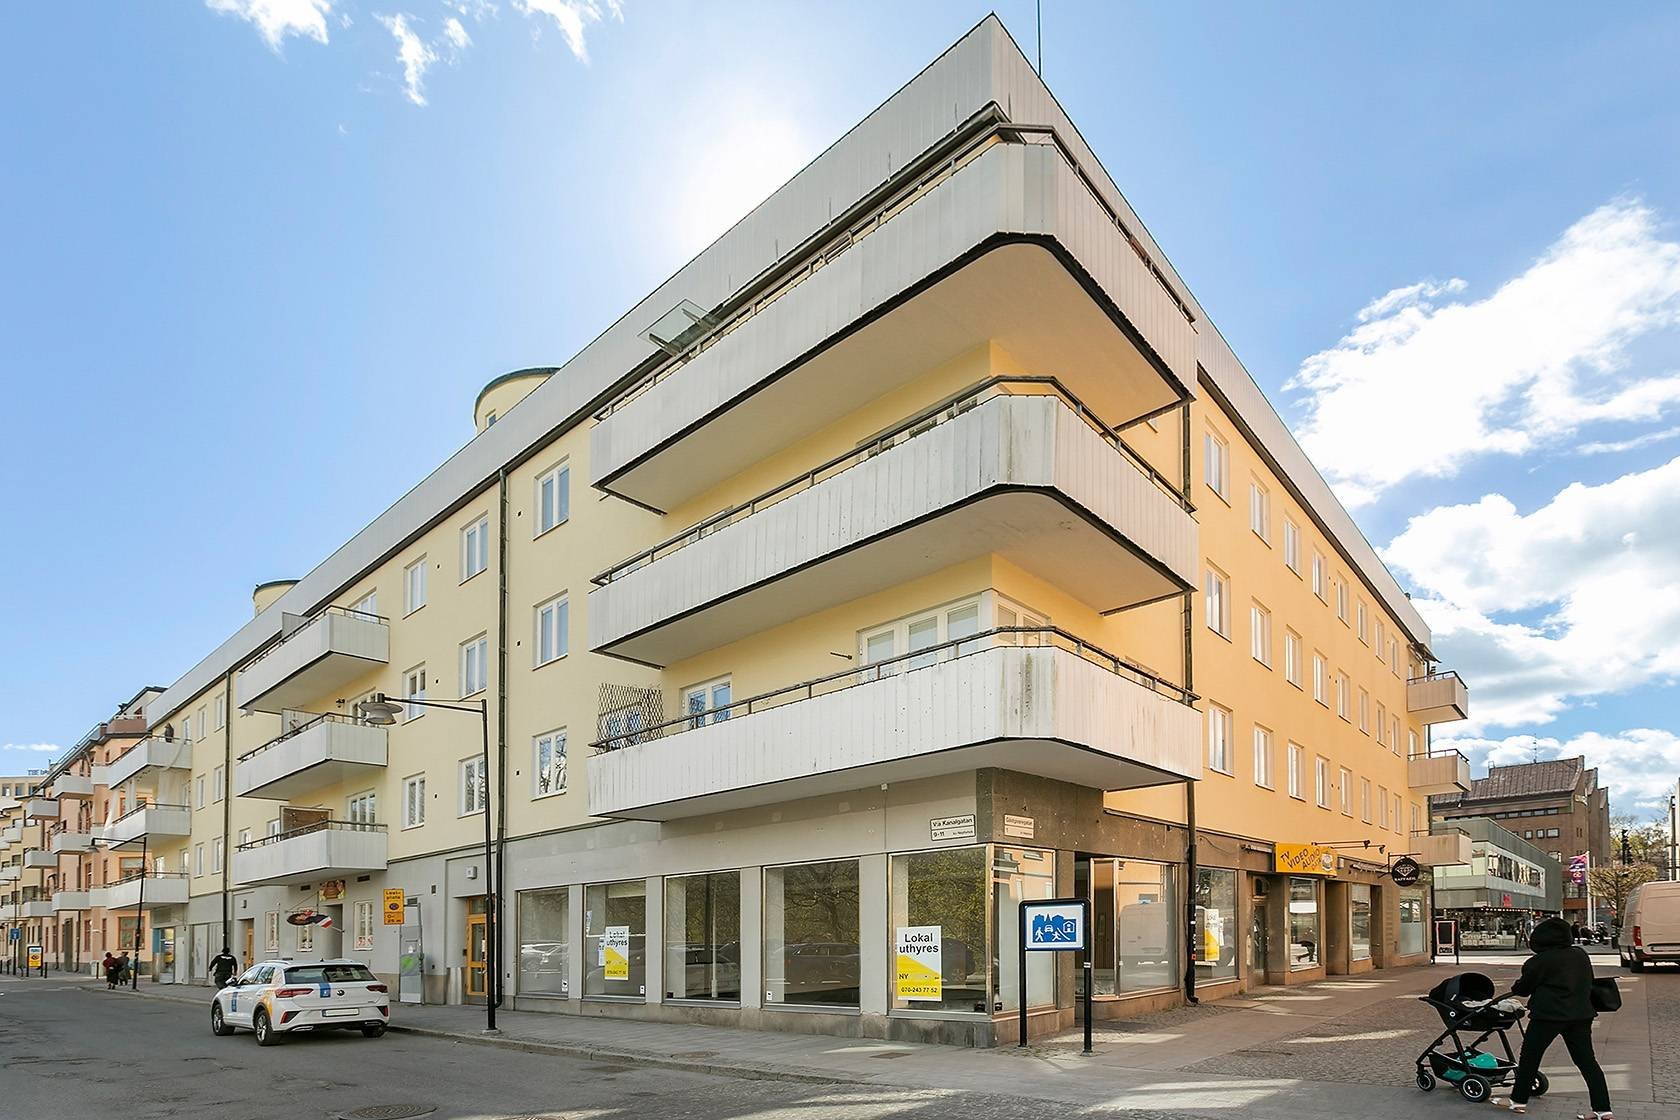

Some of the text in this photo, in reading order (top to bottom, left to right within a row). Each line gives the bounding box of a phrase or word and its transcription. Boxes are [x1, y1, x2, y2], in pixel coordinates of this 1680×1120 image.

[942, 818, 973, 827] Kanalgatan
[1280, 850, 1290, 863] TV
[1287, 848, 1309, 869] VIDEO
[1302, 848, 1321, 870] AUDIO
[606, 939, 628, 947] uthyres
[904, 933, 933, 942] Lokal
[899, 944, 939, 955] uthyres
